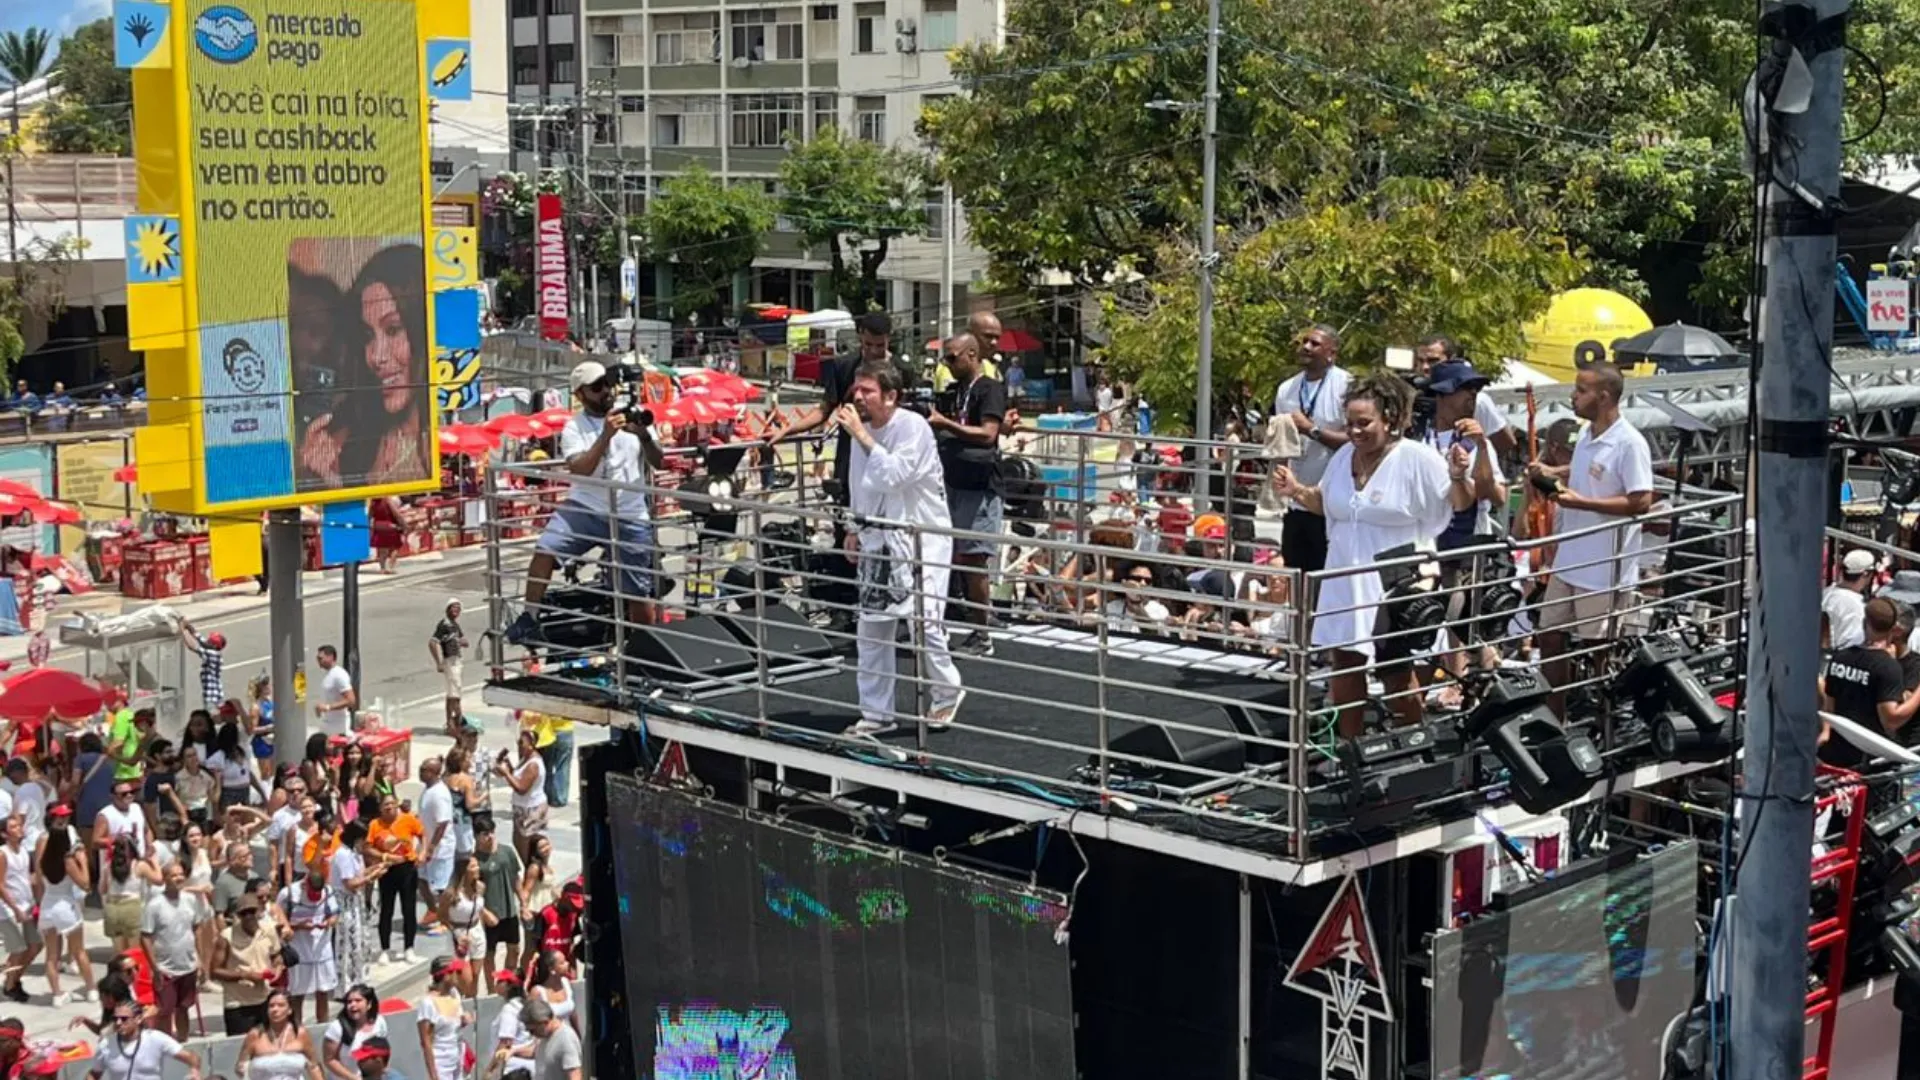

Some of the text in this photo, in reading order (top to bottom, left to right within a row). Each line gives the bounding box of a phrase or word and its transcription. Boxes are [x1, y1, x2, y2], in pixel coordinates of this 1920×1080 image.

[266, 13, 362, 38] mercado
[267, 40, 321, 67] pago
[196, 84, 408, 121] Você cai na folia,
[200, 123, 377, 151] seu cashback
[199, 158, 387, 185] vem em dobro
[202, 191, 335, 221] no cartão.
[540, 218, 567, 318] BRAHMA
[1830, 662, 1870, 685] EQUIPE
